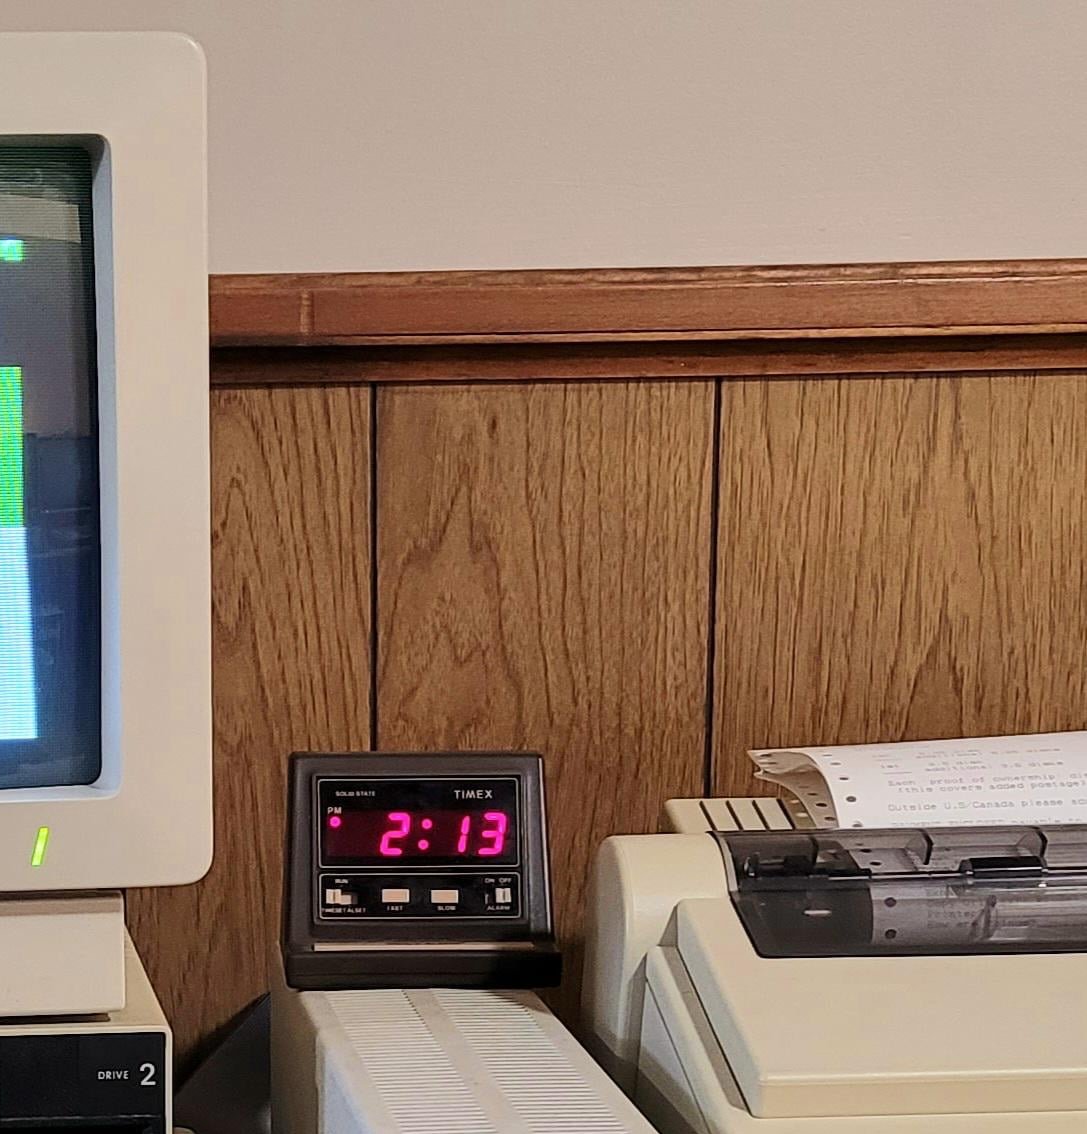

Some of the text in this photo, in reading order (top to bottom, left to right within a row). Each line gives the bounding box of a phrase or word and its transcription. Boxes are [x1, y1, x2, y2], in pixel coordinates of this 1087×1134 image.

[929, 777, 964, 785] proof
[993, 773, 1056, 782] ownership
[939, 784, 982, 792] covers
[989, 782, 1024, 790] added
[454, 789, 493, 800] TIMEX
[327, 806, 342, 815] PM
[888, 802, 937, 812] Outside
[1021, 798, 1064, 808] please
[378, 811, 508, 858] 2:13
[97, 1063, 156, 1086] DRIVE 2
